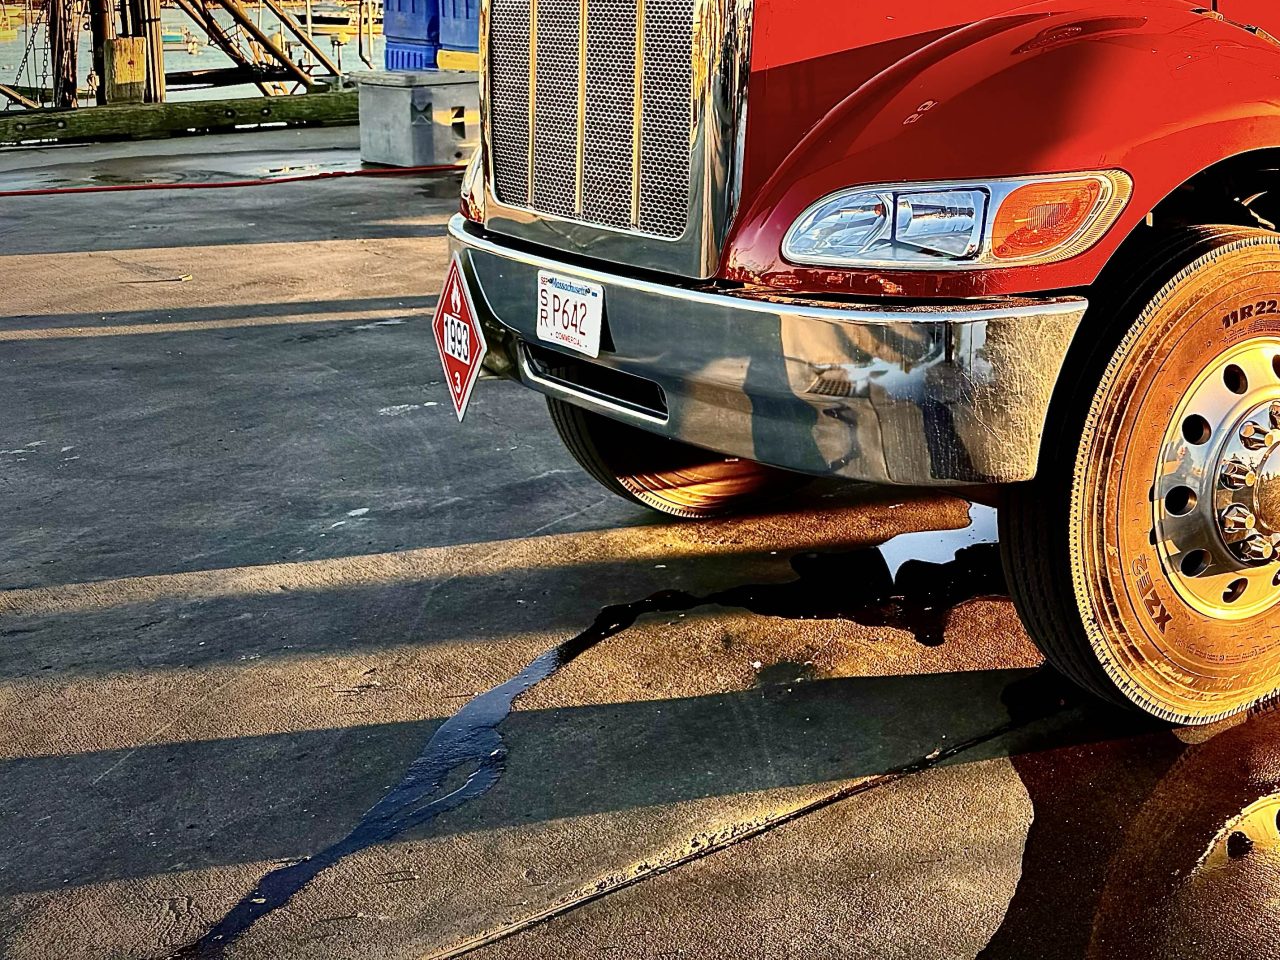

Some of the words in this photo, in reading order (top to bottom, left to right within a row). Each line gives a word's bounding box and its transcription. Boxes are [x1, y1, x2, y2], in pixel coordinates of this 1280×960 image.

[552, 293, 587, 337] P642
[445, 316, 470, 363] 1993
[454, 371, 461, 394] 3
